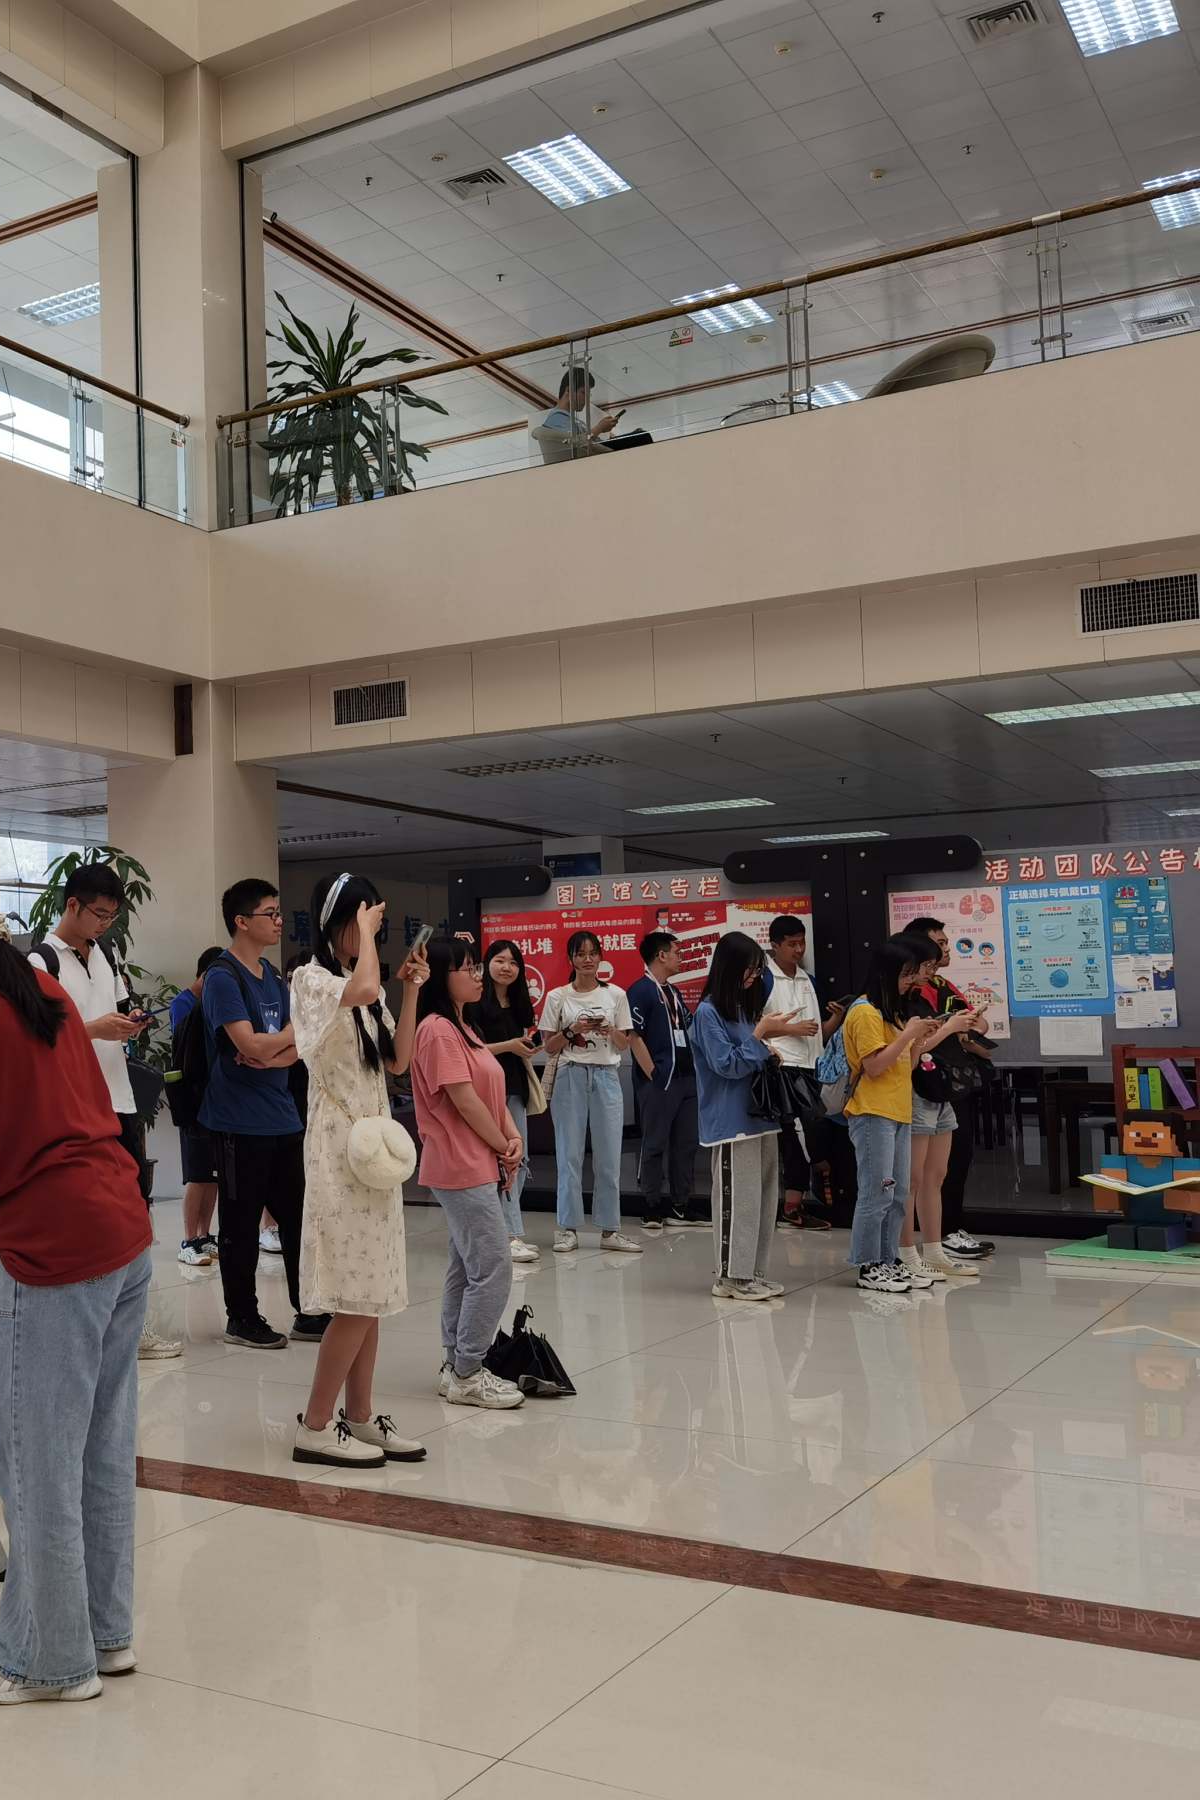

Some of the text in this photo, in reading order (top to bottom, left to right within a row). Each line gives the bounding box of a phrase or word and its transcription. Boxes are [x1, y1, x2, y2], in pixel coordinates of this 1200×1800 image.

[984, 847, 1200, 882] 活动团队公告
[556, 876, 721, 905] 图书馆公告栏
[597, 933, 637, 951] 就医
